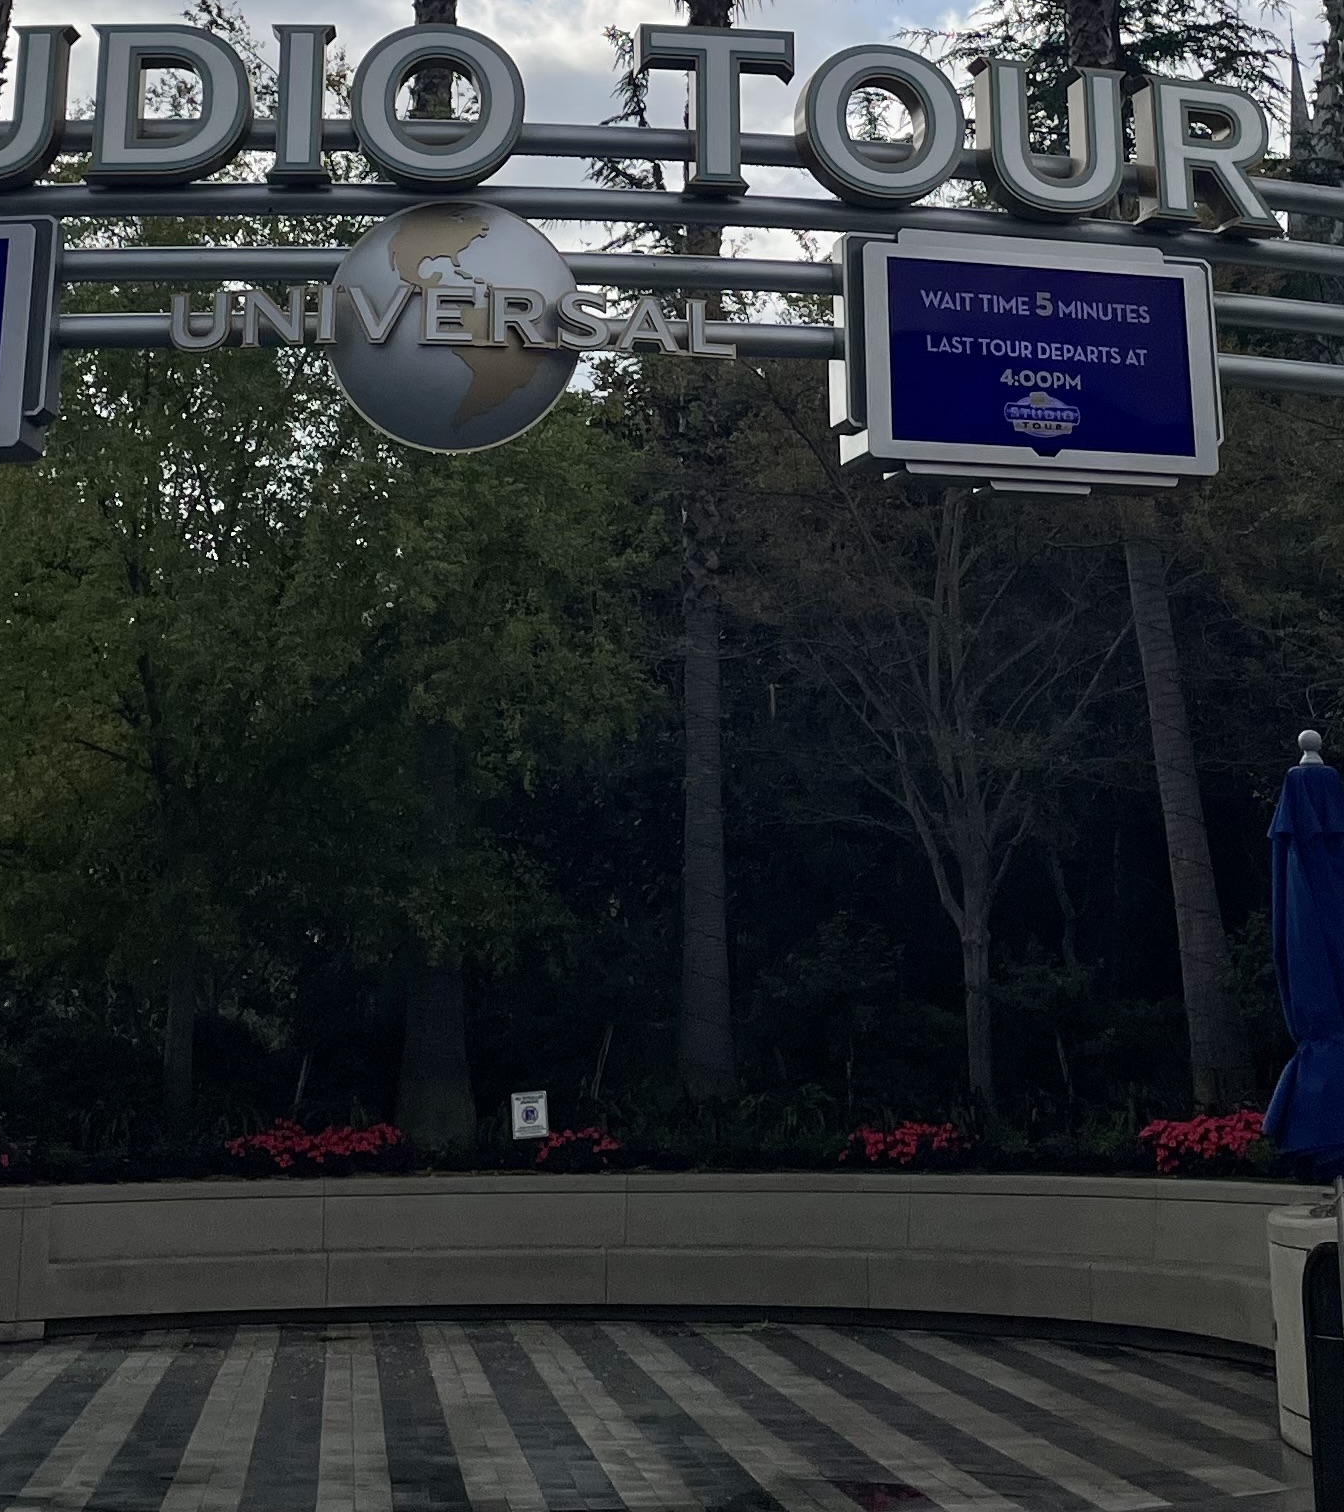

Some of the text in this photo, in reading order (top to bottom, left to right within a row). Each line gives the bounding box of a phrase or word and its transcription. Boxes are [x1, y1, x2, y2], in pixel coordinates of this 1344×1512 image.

[633, 23, 1285, 237] TOUR
[168, 284, 737, 360] UNIVERSAL
[920, 290, 1151, 324] WAIT TIME 5 MINUTES
[926, 335, 1148, 366] LAST TOUR DEPARTS AT
[999, 368, 1082, 391] 4:00PM
[1010, 406, 1075, 421] STUDIO
[1022, 421, 1063, 431] TOUR
